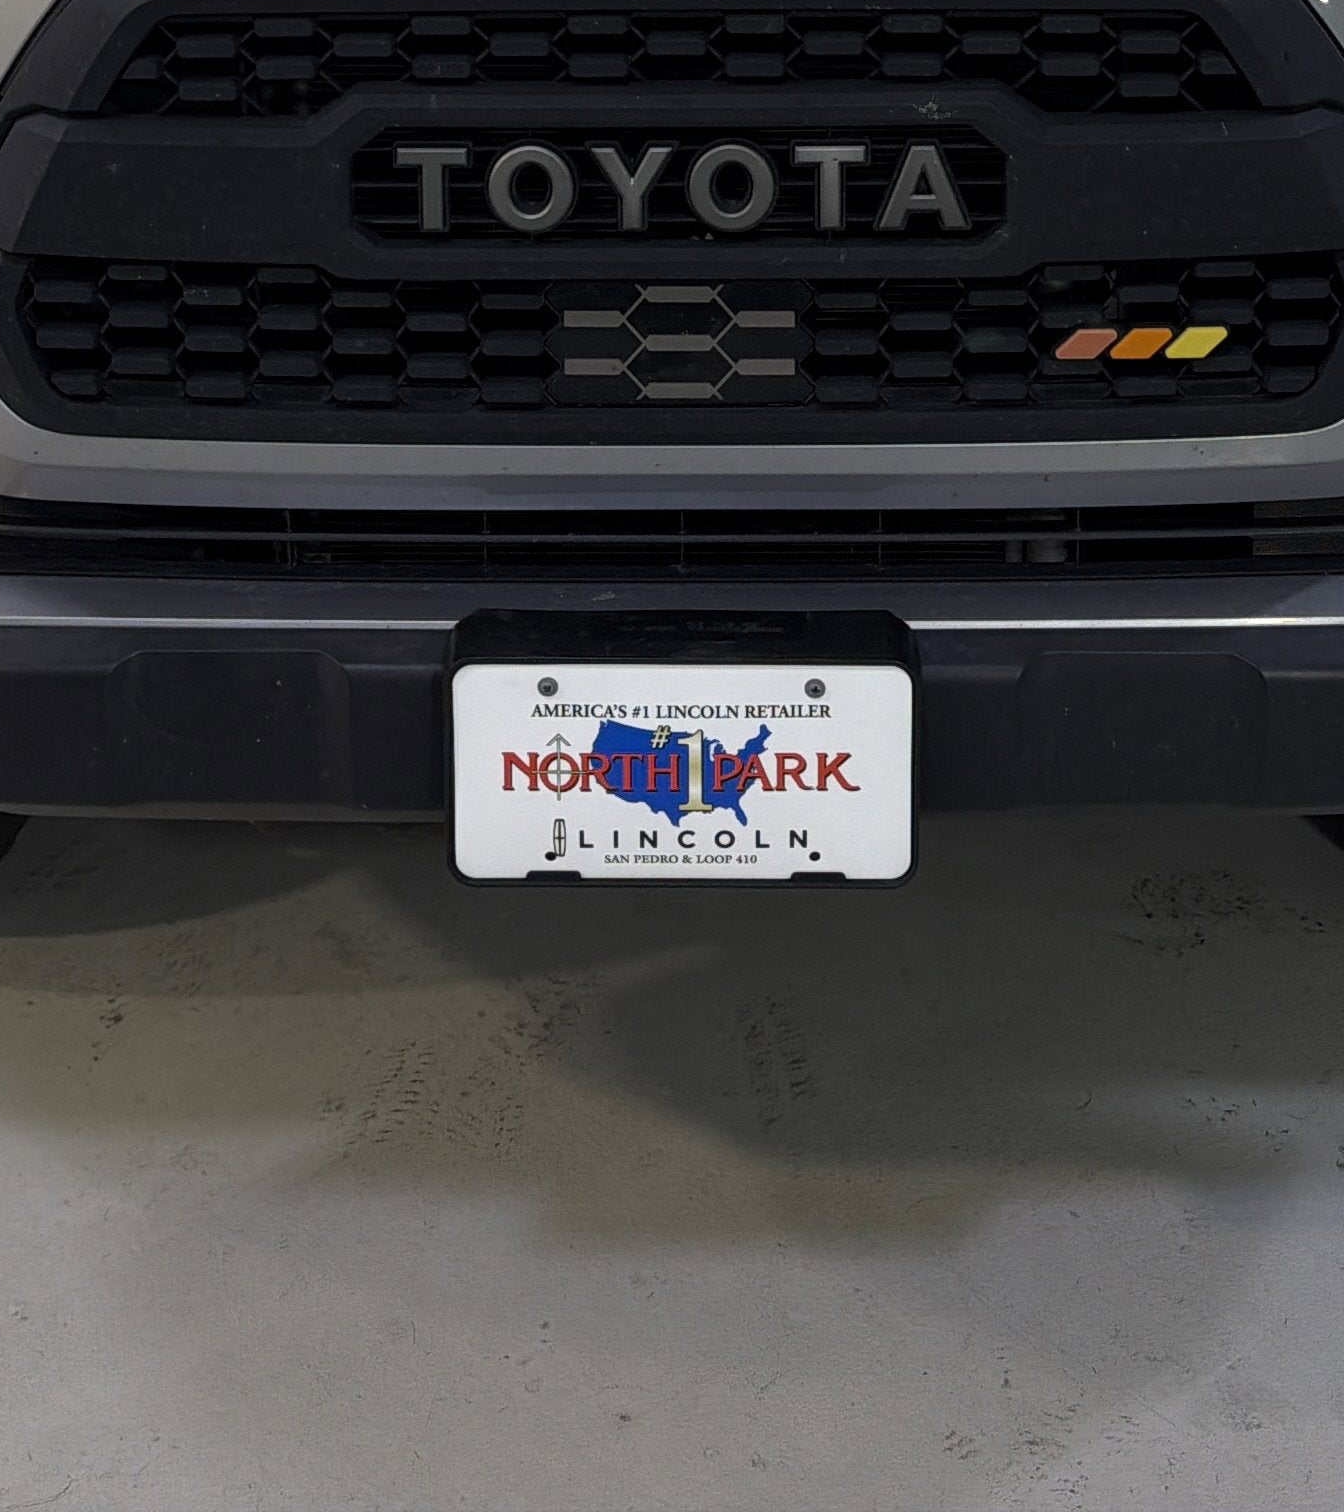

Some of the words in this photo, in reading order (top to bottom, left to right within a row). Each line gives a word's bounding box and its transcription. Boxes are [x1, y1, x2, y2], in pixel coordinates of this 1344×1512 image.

[392, 141, 973, 233] TOYOTA
[530, 703, 628, 719] AMERICA'S
[632, 705, 650, 719] #1
[655, 704, 740, 720] LINCOLN
[744, 704, 832, 719] RETAILER
[501, 751, 681, 792] NORTH
[712, 751, 861, 793] PARK
[578, 829, 809, 849] LINCOLN
[604, 854, 630, 865] SAN
[633, 854, 679, 865] PEDRO
[682, 854, 693, 865] &
[696, 854, 733, 865] LOOP
[736, 854, 758, 865] 410
